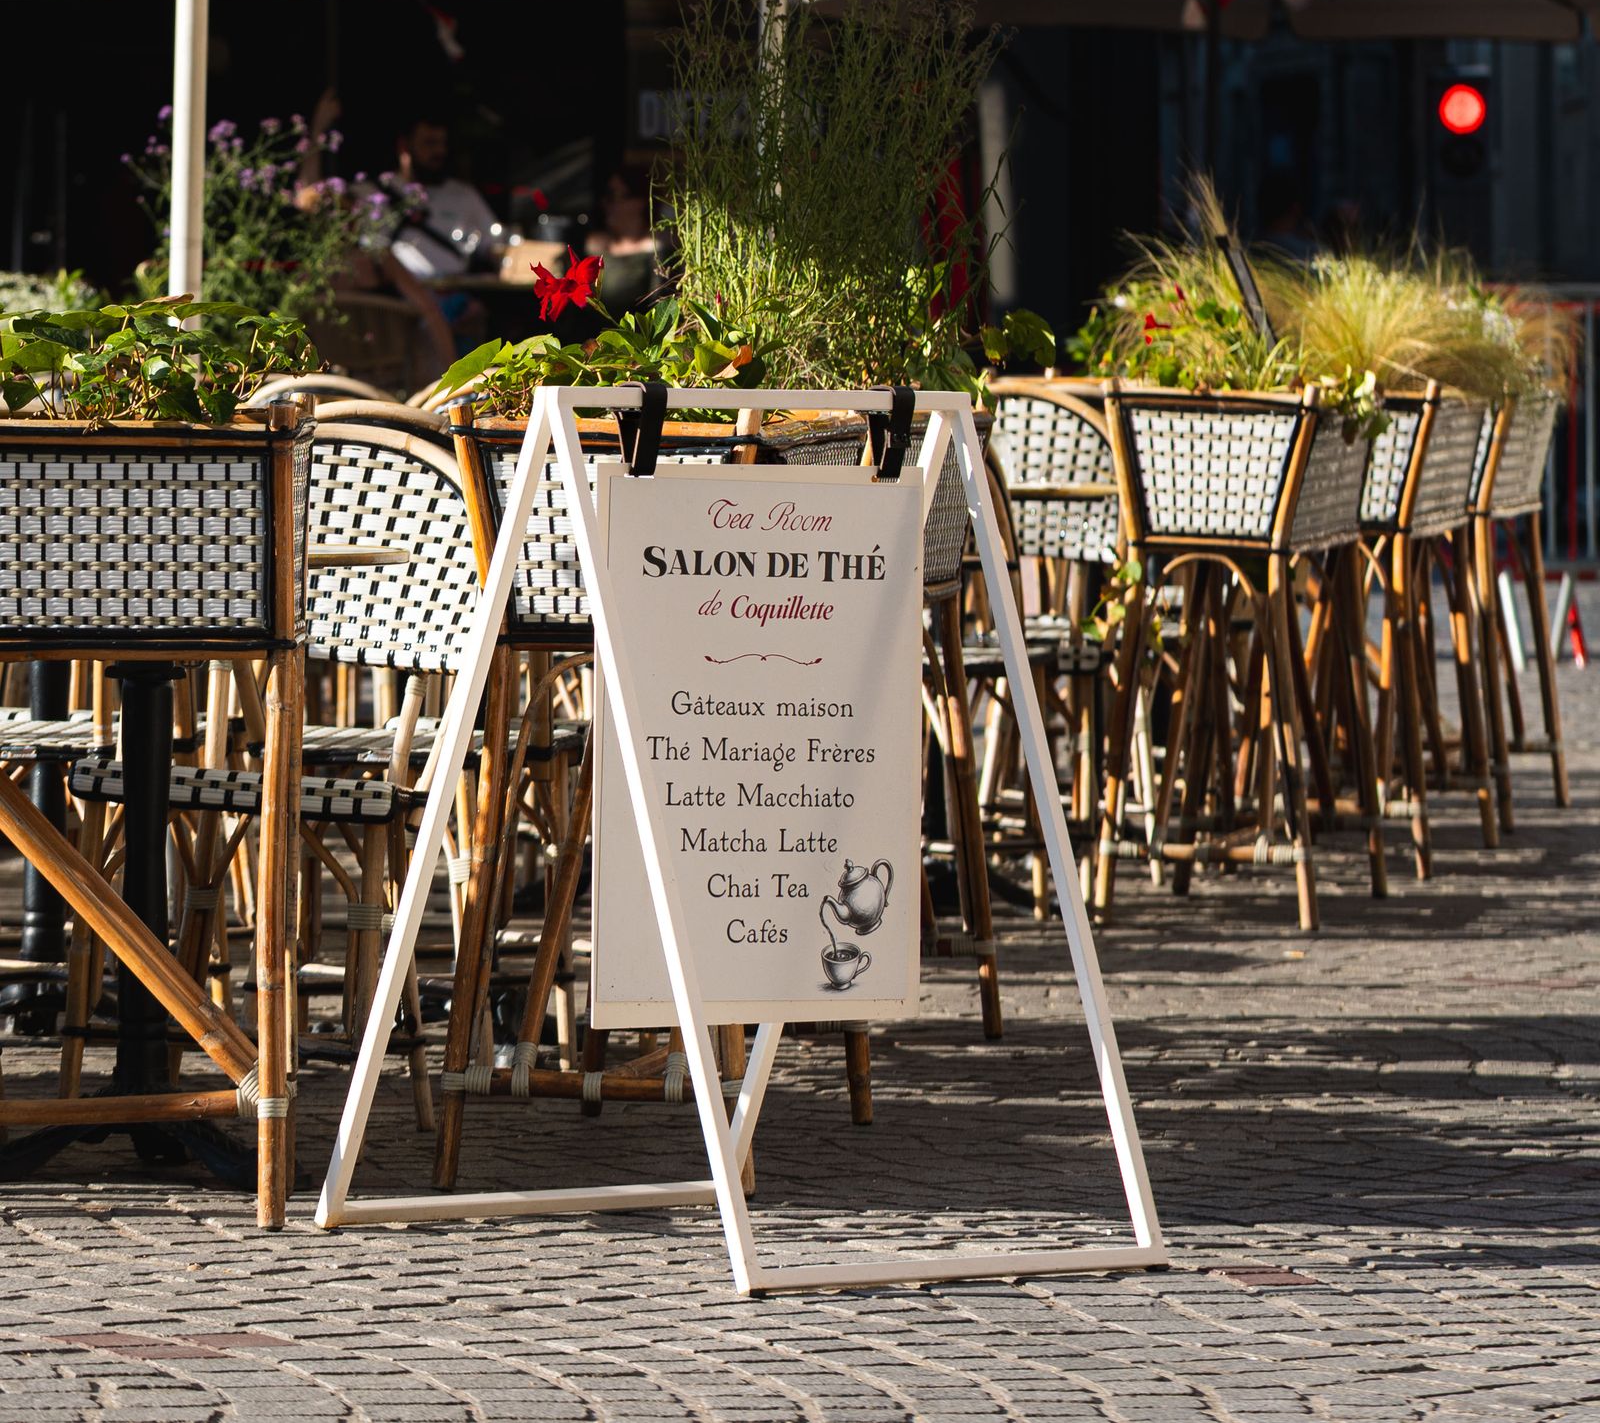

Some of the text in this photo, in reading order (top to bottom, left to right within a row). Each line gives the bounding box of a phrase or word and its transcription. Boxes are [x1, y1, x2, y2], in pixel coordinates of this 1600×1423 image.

[707, 498, 833, 532] Tea Room
[642, 543, 887, 583] SALON DE THÉ
[697, 588, 835, 628] de Coquillette
[670, 690, 855, 718] Gâteaux maison
[646, 735, 876, 773] Thé Mariage Frères
[664, 781, 855, 809] Latte Macchiato
[680, 827, 838, 854] Matcha Latte
[707, 872, 810, 899] Chai Tea
[726, 918, 789, 944] Cafés
